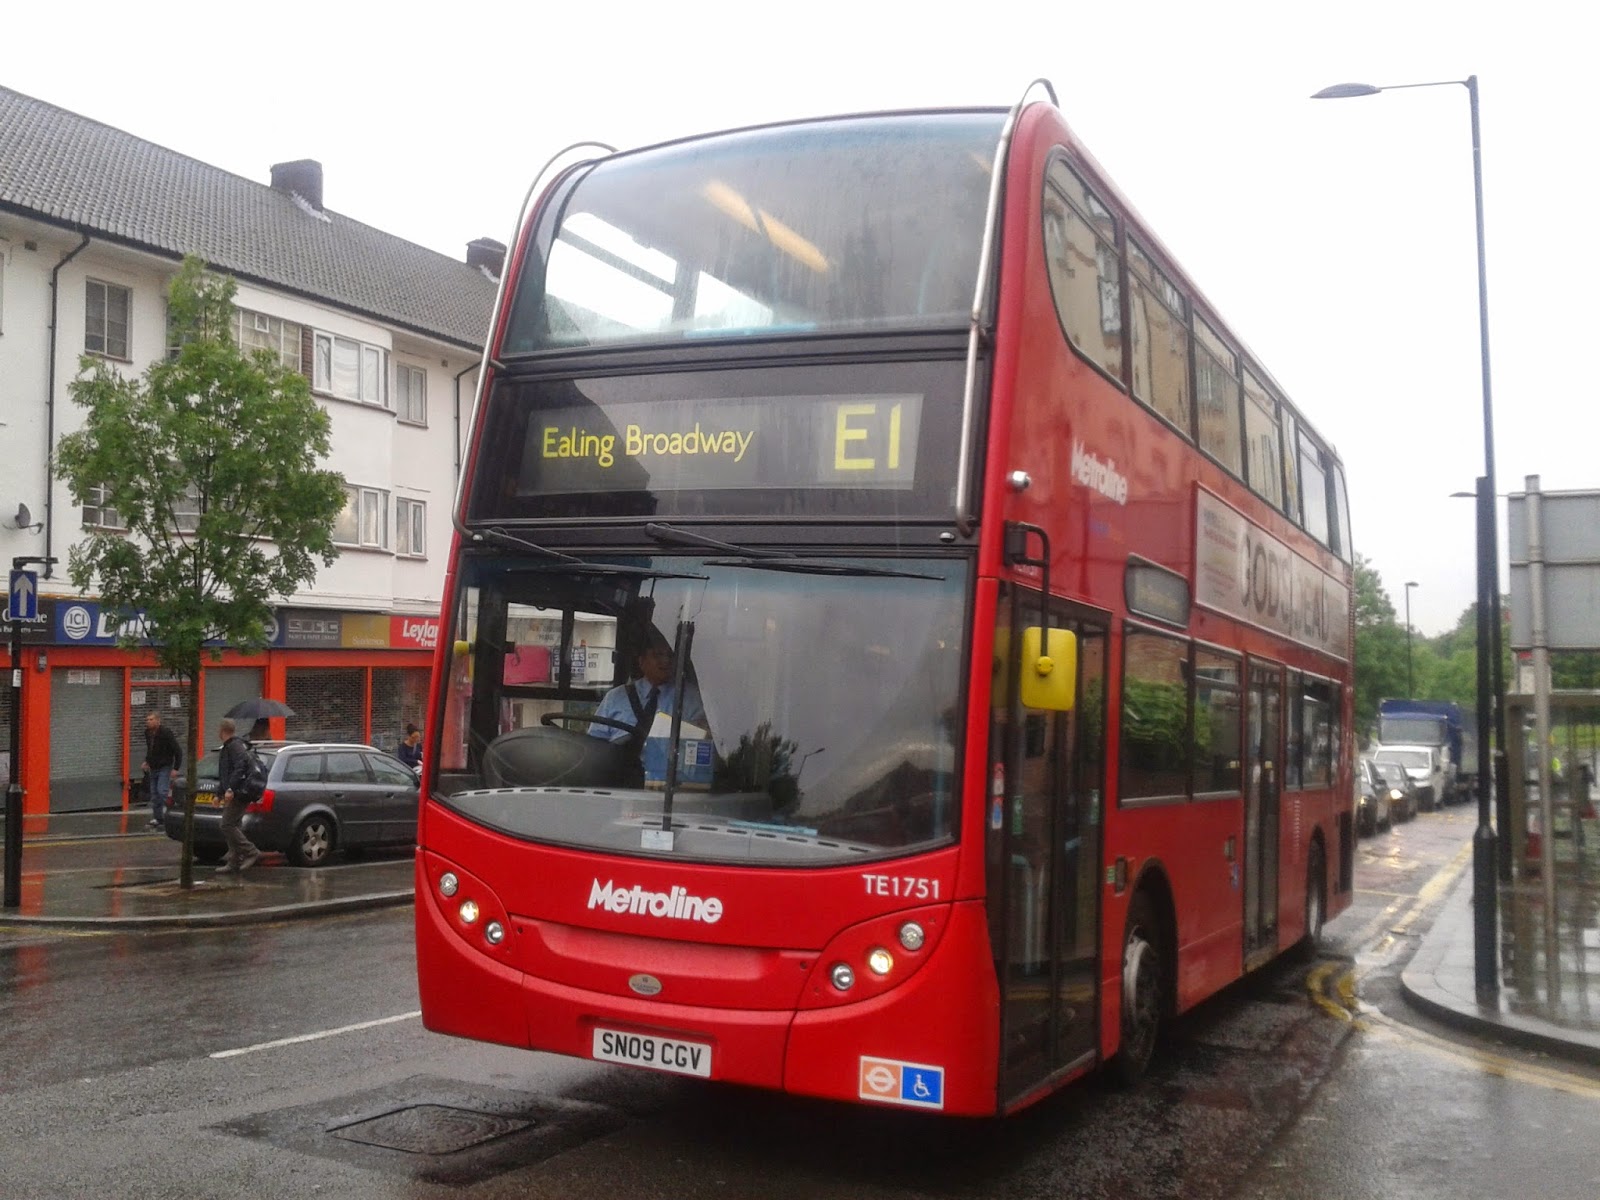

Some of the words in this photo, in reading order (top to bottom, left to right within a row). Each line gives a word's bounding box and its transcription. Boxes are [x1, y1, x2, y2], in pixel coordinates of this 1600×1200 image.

[542, 427, 616, 467] Ealing
[625, 423, 754, 463] Broadway
[834, 403, 902, 470] E1
[1071, 437, 1128, 506] Metroline
[69, 612, 86, 626] ICI
[587, 878, 723, 924] Metroline
[862, 874, 940, 900] TE1751
[601, 1032, 655, 1062] SN09
[660, 1041, 702, 1070] CGV
